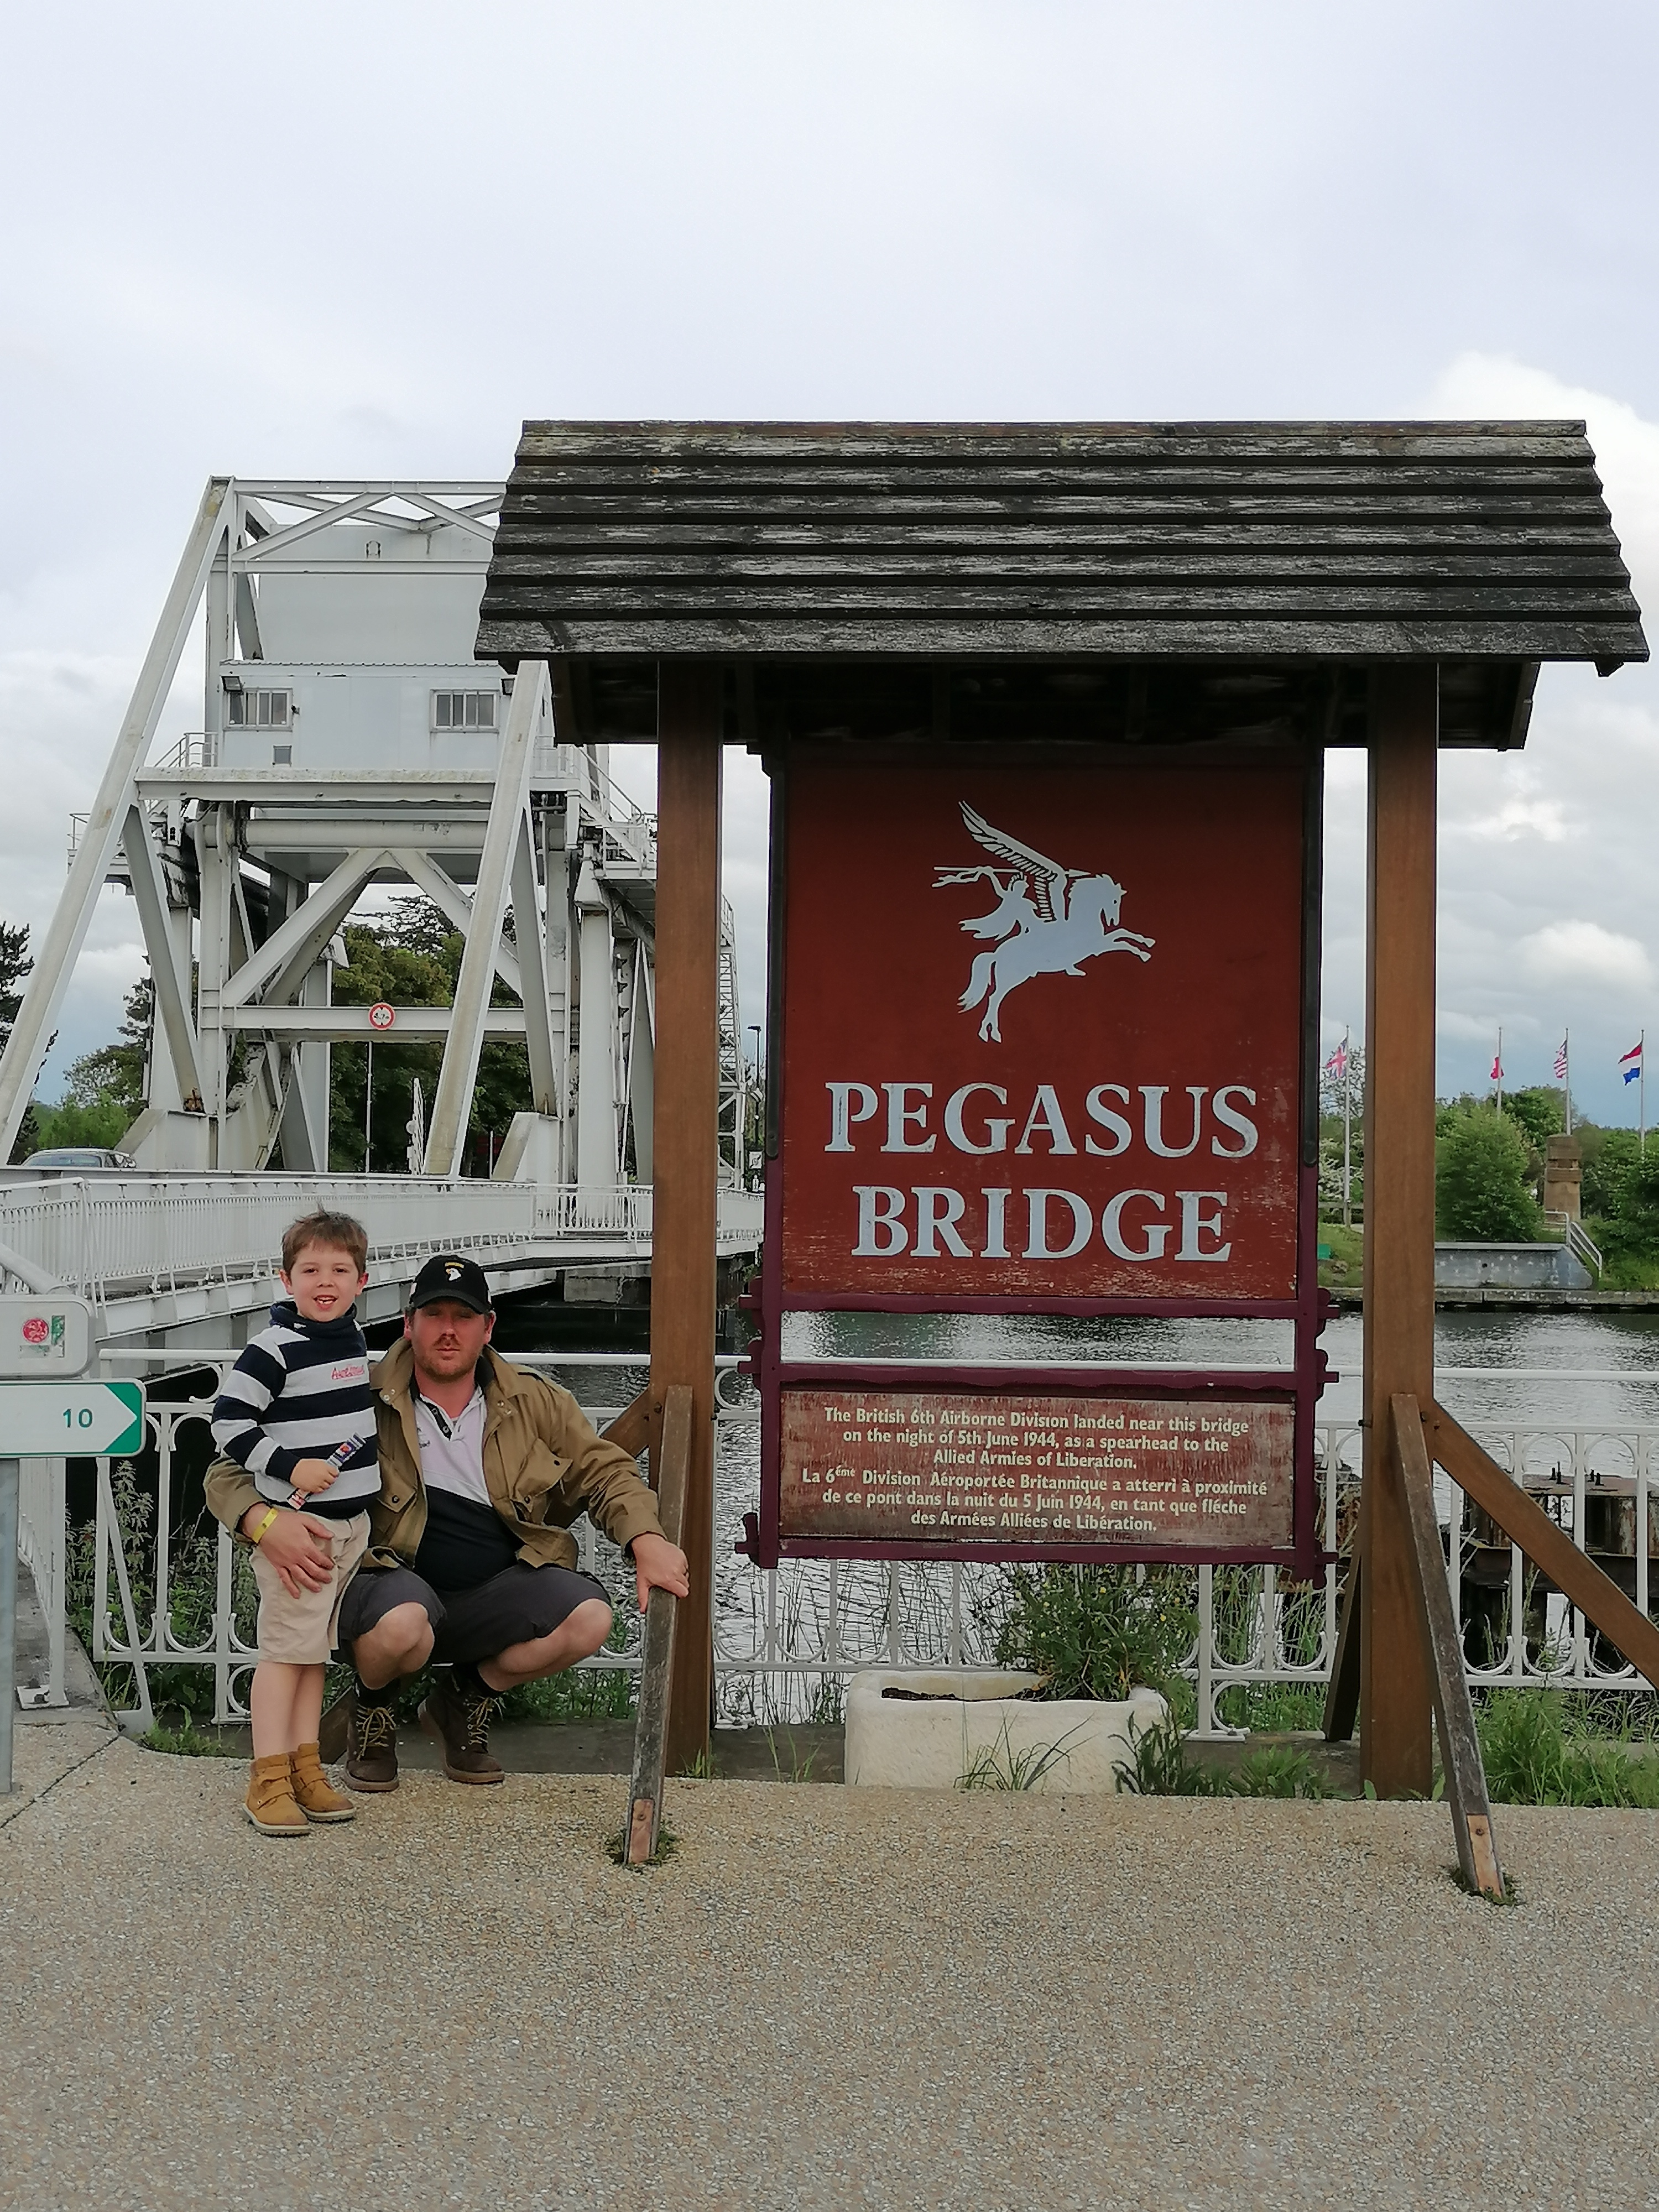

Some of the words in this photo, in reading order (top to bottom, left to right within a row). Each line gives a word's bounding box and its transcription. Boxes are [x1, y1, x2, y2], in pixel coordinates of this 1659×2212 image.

[824, 1082, 1259, 1158] PEGASUS
[851, 1186, 1232, 1262] BRIDGE
[62, 1408, 93, 1428] 10
[825, 1407, 851, 1422] The
[856, 1408, 905, 1423] British
[910, 1409, 935, 1424] 6th
[940, 1411, 1005, 1426] Airborne
[1010, 1413, 1068, 1428] Division
[1074, 1414, 1124, 1430] landed
[1129, 1419, 1164, 1431] near
[1168, 1417, 1196, 1431] this
[1201, 1418, 1249, 1436] bridge
[843, 1431, 862, 1442] on
[867, 1428, 890, 1443] the
[896, 1429, 934, 1447] night
[939, 1430, 953, 1444] of
[958, 1430, 982, 1444] 5th
[985, 1432, 1019, 1448] June
[1024, 1433, 1060, 1449] 1944,
[1065, 1437, 1081, 1447] as
[1086, 1438, 1094, 1448] a
[1100, 1436, 1177, 1453] spearhead
[1184, 1439, 1199, 1451] to
[1205, 1437, 1228, 1452] the
[934, 1449, 975, 1464] Allied
[980, 1451, 1032, 1465] Armies
[1037, 1453, 1052, 1467] of
[1056, 1454, 1136, 1468] Liberation.
[802, 1468, 820, 1483] La
[863, 1470, 920, 1485] Division
[930, 1472, 1015, 1490] Aéroportée
[1020, 1474, 1107, 1494] Britannique
[1113, 1481, 1121, 1491] a
[1126, 1478, 1176, 1492] atterri
[1182, 1479, 1190, 1493] à
[1196, 1481, 1267, 1496] proximité
[823, 1489, 840, 1503] de
[846, 1493, 862, 1504] ce
[867, 1490, 901, 1507] pont
[906, 1490, 941, 1505] dans
[947, 1491, 959, 1506] la
[964, 1492, 994, 1507] nuit
[999, 1492, 1017, 1507] du
[1023, 1494, 1031, 1507] 5
[1036, 1495, 1063, 1512] Juin
[1070, 1496, 1105, 1512] 1944,
[1110, 1500, 1128, 1510] en
[1134, 1498, 1165, 1512] tant
[1170, 1503, 1197, 1516] que
[911, 1510, 936, 1525] des
[940, 1512, 995, 1526] Armées
[1000, 1514, 1048, 1527] Alliées
[1052, 1515, 1071, 1528] de
[1076, 1516, 1157, 1532] Libération.
